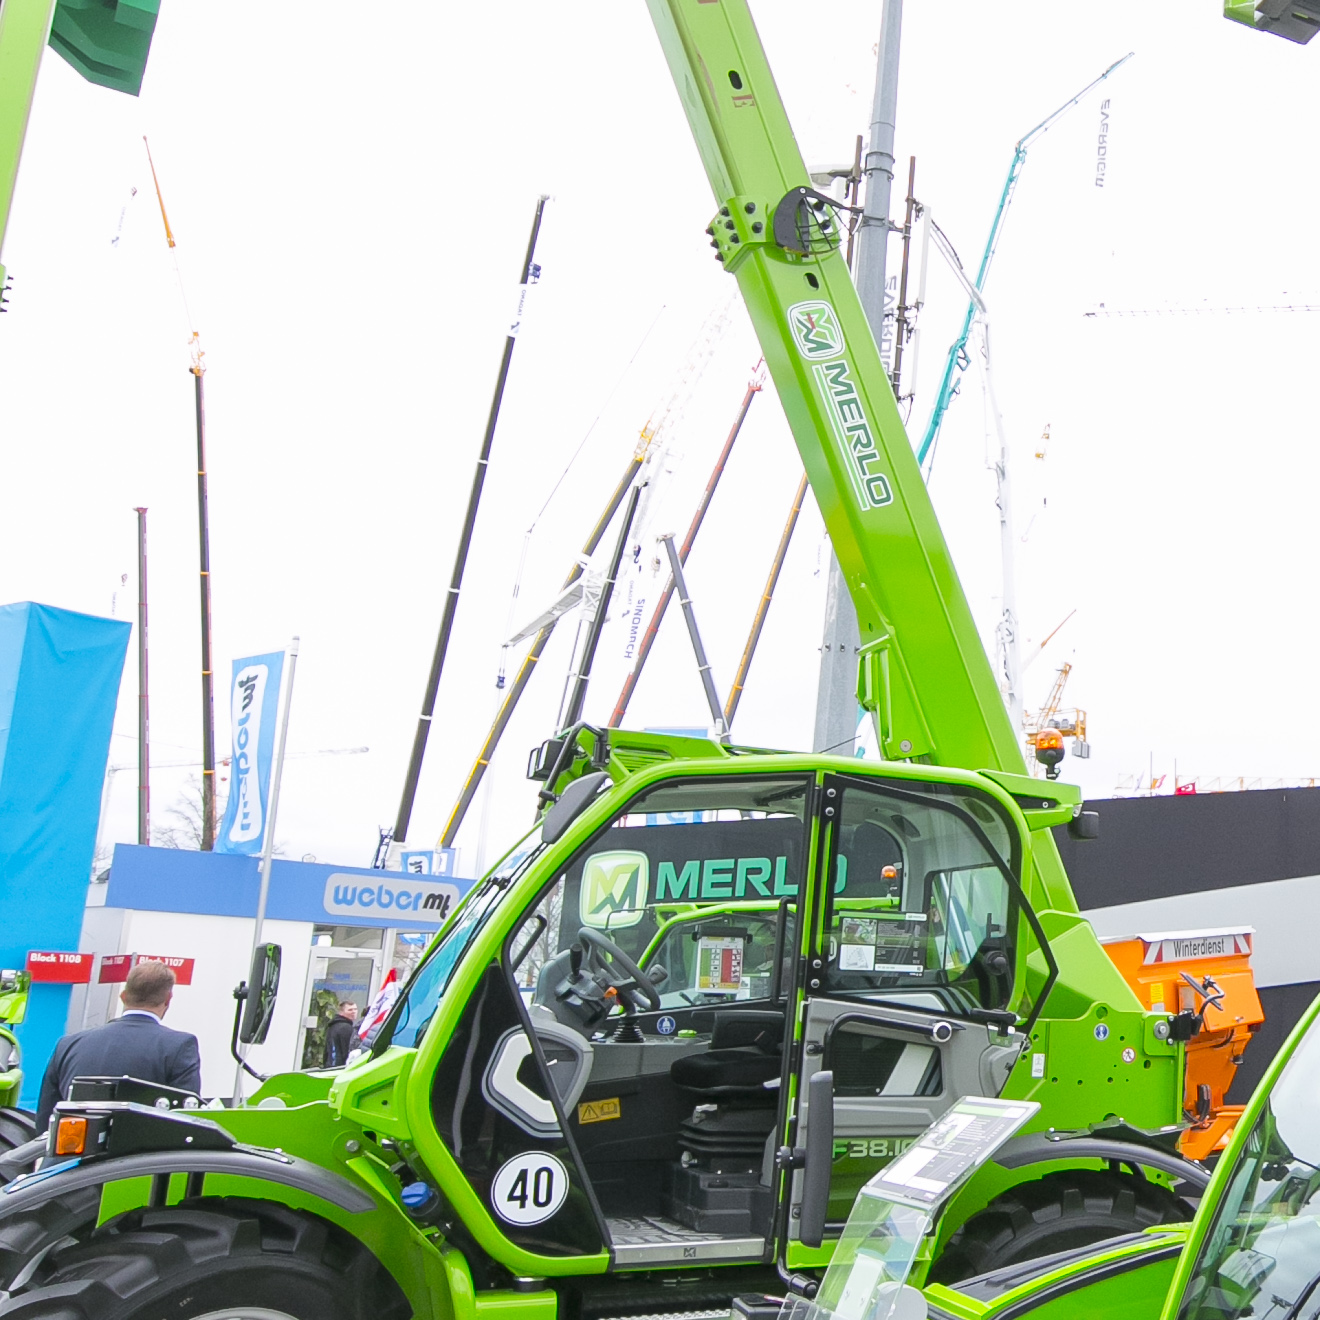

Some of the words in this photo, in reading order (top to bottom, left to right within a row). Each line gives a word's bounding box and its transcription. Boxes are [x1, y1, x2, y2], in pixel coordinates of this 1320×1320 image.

[824, 360, 894, 509] MERLO
[30, 952, 57, 963] Block
[59, 953, 82, 964] 1108
[1173, 937, 1225, 958] Winterdienst
[507, 1166, 554, 1209] 40
